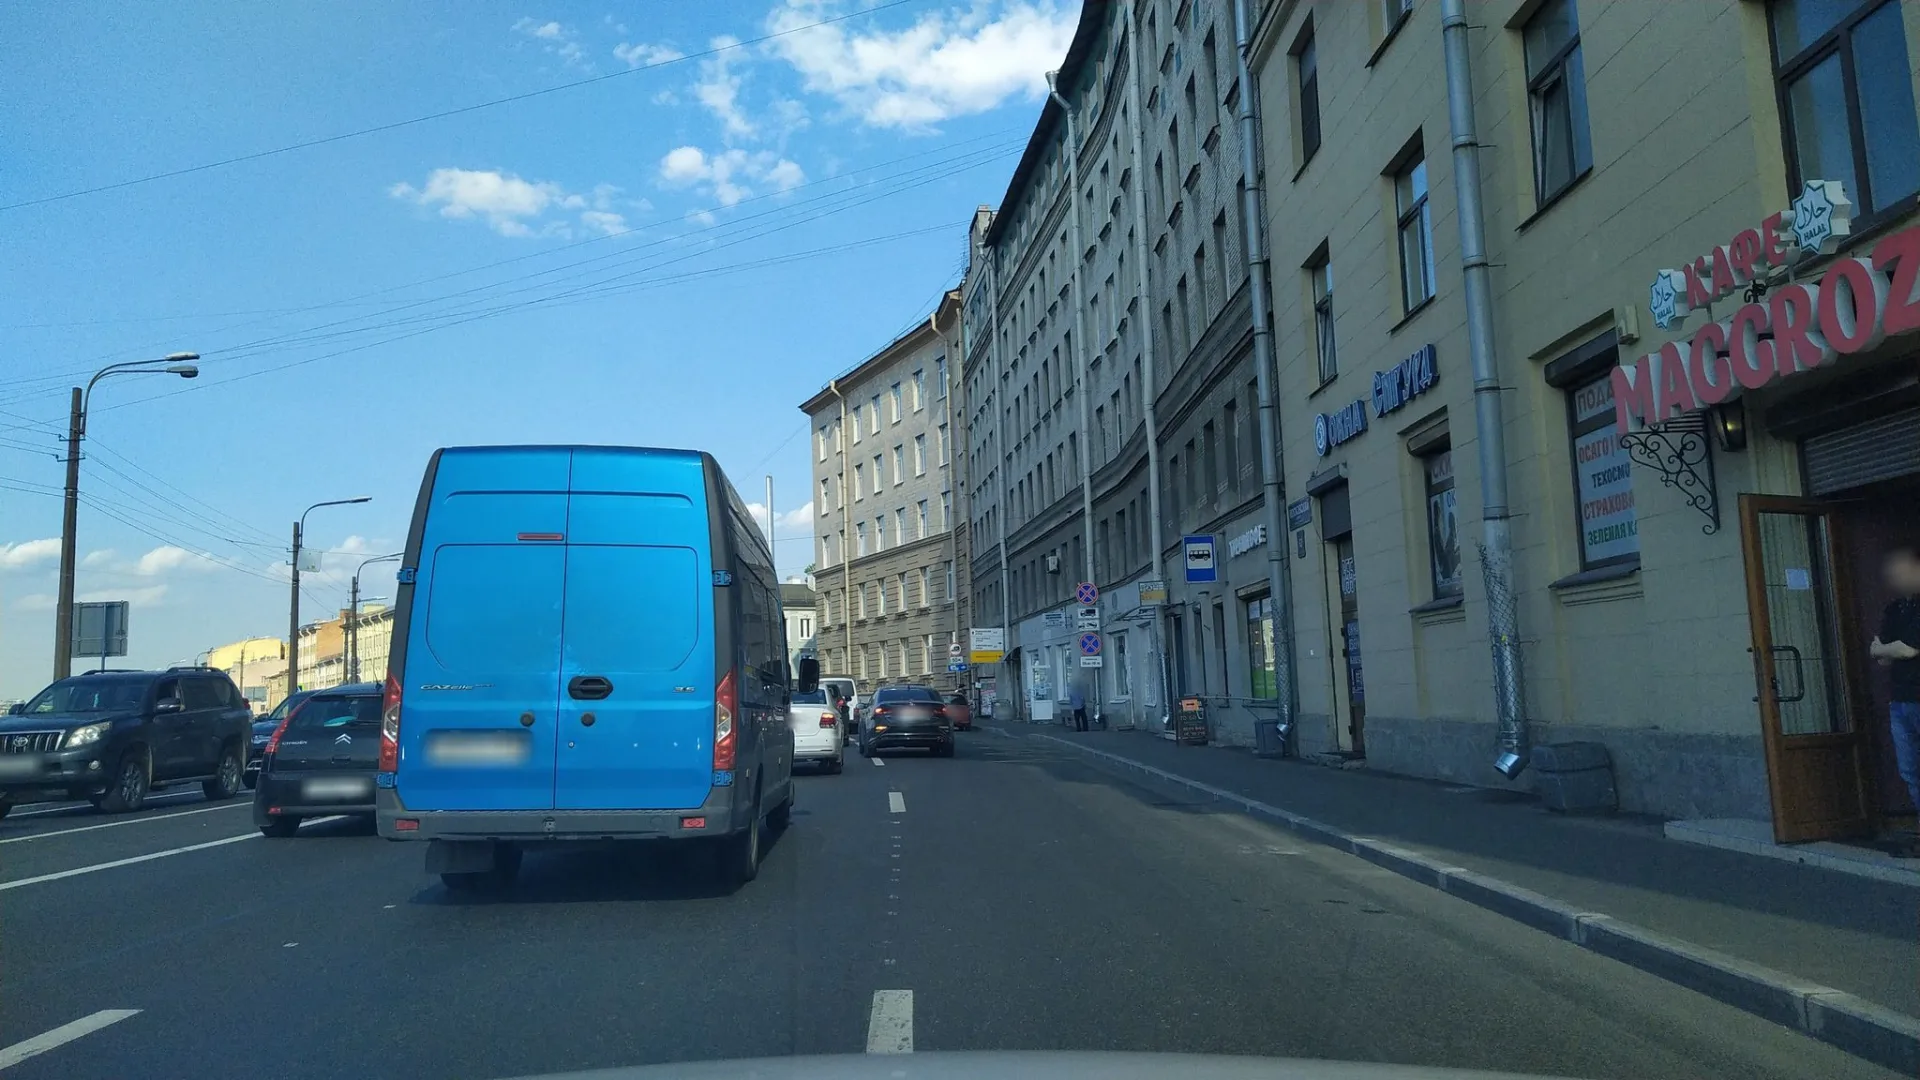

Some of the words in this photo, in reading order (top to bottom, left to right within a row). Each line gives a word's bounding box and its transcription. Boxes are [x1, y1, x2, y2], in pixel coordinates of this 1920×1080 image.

[1803, 223, 1827, 242] HALAL
[1683, 211, 1787, 309] КАФЕ
[1610, 225, 1920, 434] MACCROZ
[1657, 305, 1672, 320] HALAL
[1328, 400, 1366, 447] ОКНА
[1587, 521, 1627, 546] ЗЕЛЕНАЯ
